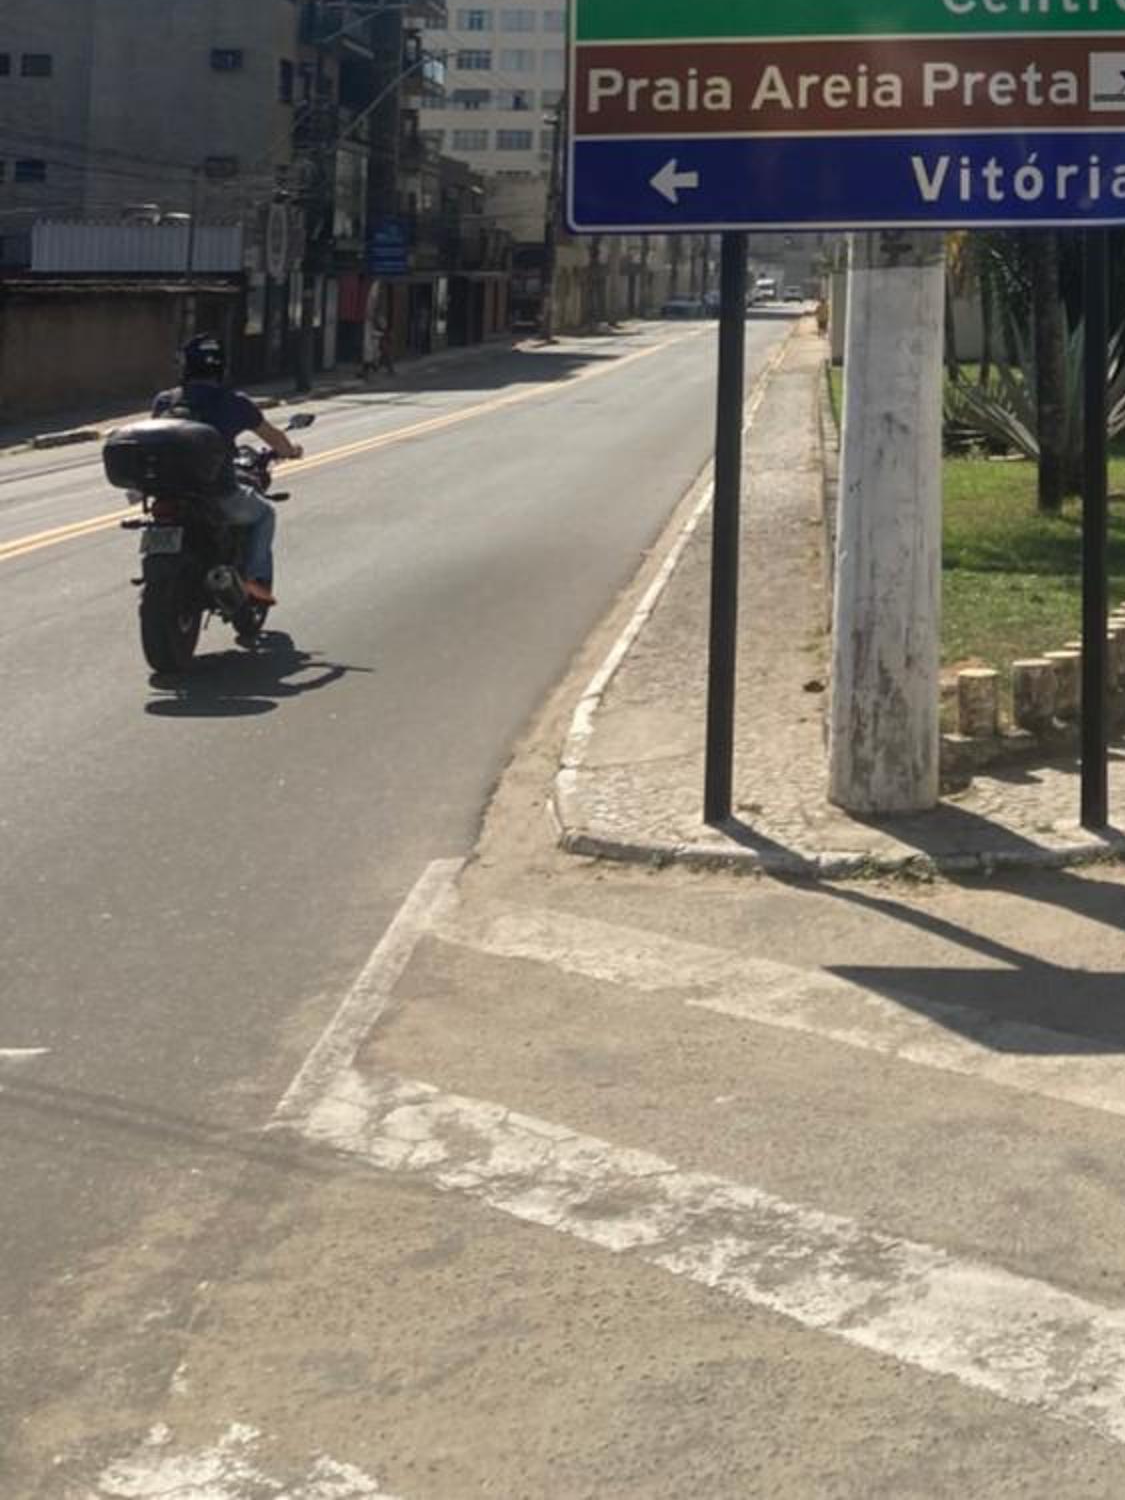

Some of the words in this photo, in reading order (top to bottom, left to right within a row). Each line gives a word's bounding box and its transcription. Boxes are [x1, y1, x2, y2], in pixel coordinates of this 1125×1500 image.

[588, 67, 732, 113] Praia
[751, 63, 903, 110] Areia
[923, 62, 1078, 107] Preta
